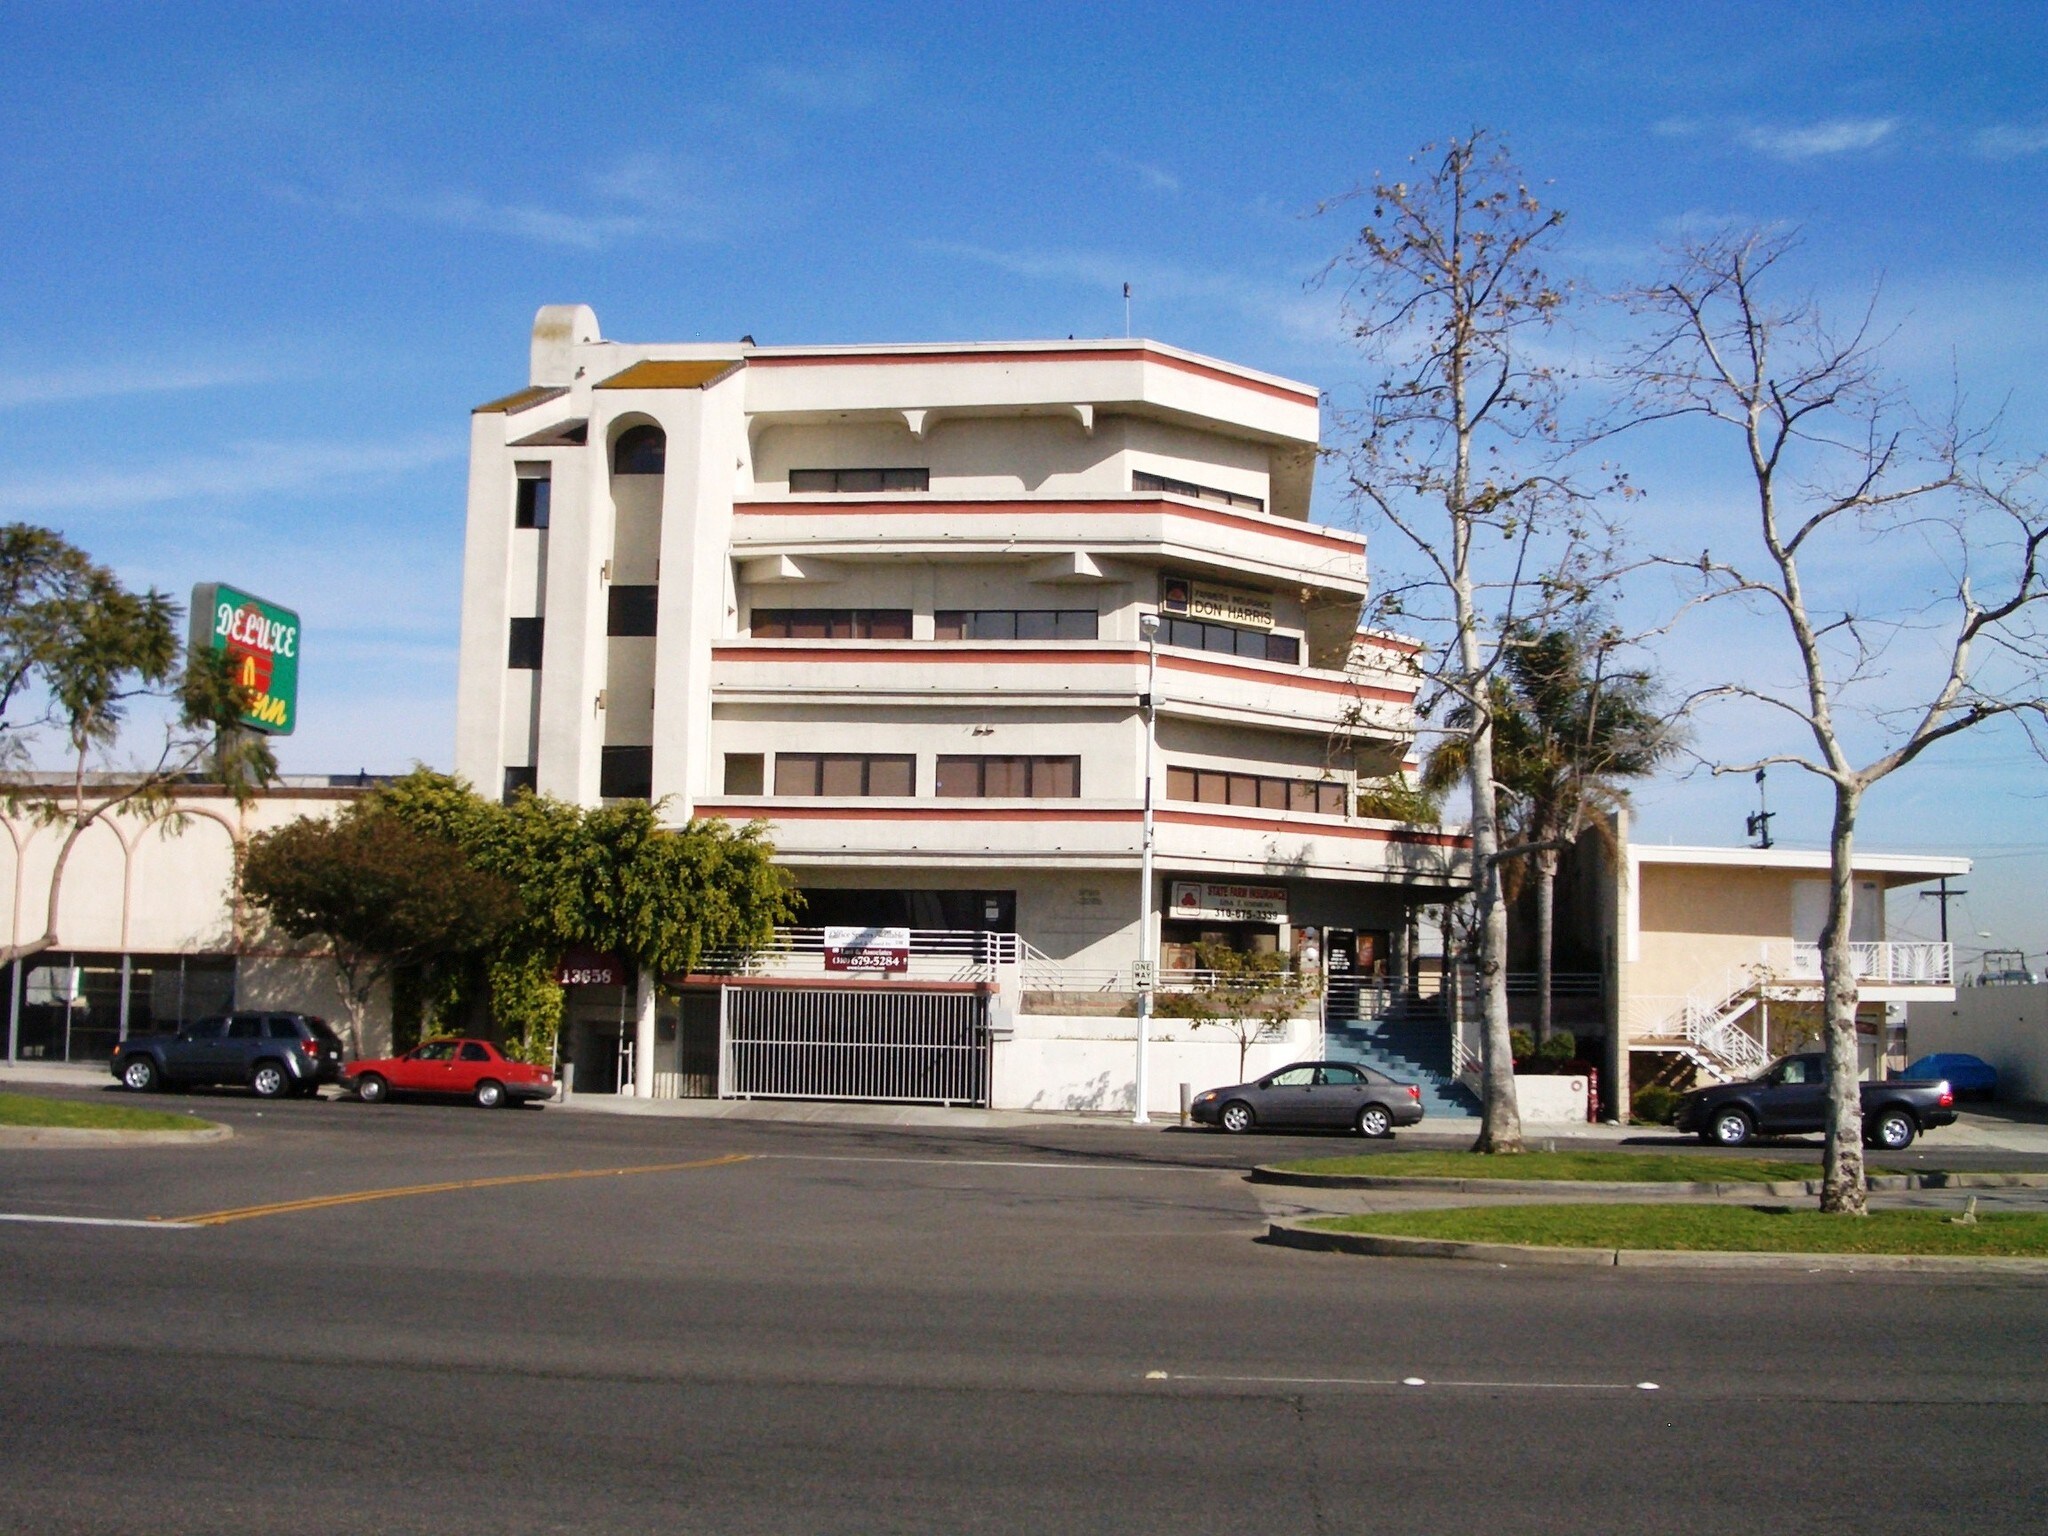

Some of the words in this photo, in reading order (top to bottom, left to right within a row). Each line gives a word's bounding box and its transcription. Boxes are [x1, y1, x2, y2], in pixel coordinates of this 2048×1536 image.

[1195, 600, 1222, 616] DON
[1227, 604, 1272, 625] HARRIS
[216, 603, 296, 658] DELUXE
[1207, 885, 1228, 897] STATE
[1230, 886, 1248, 898] FARM
[851, 956, 900, 966] 679-5284
[1135, 963, 1151, 971] ONE
[561, 969, 612, 984] 13658
